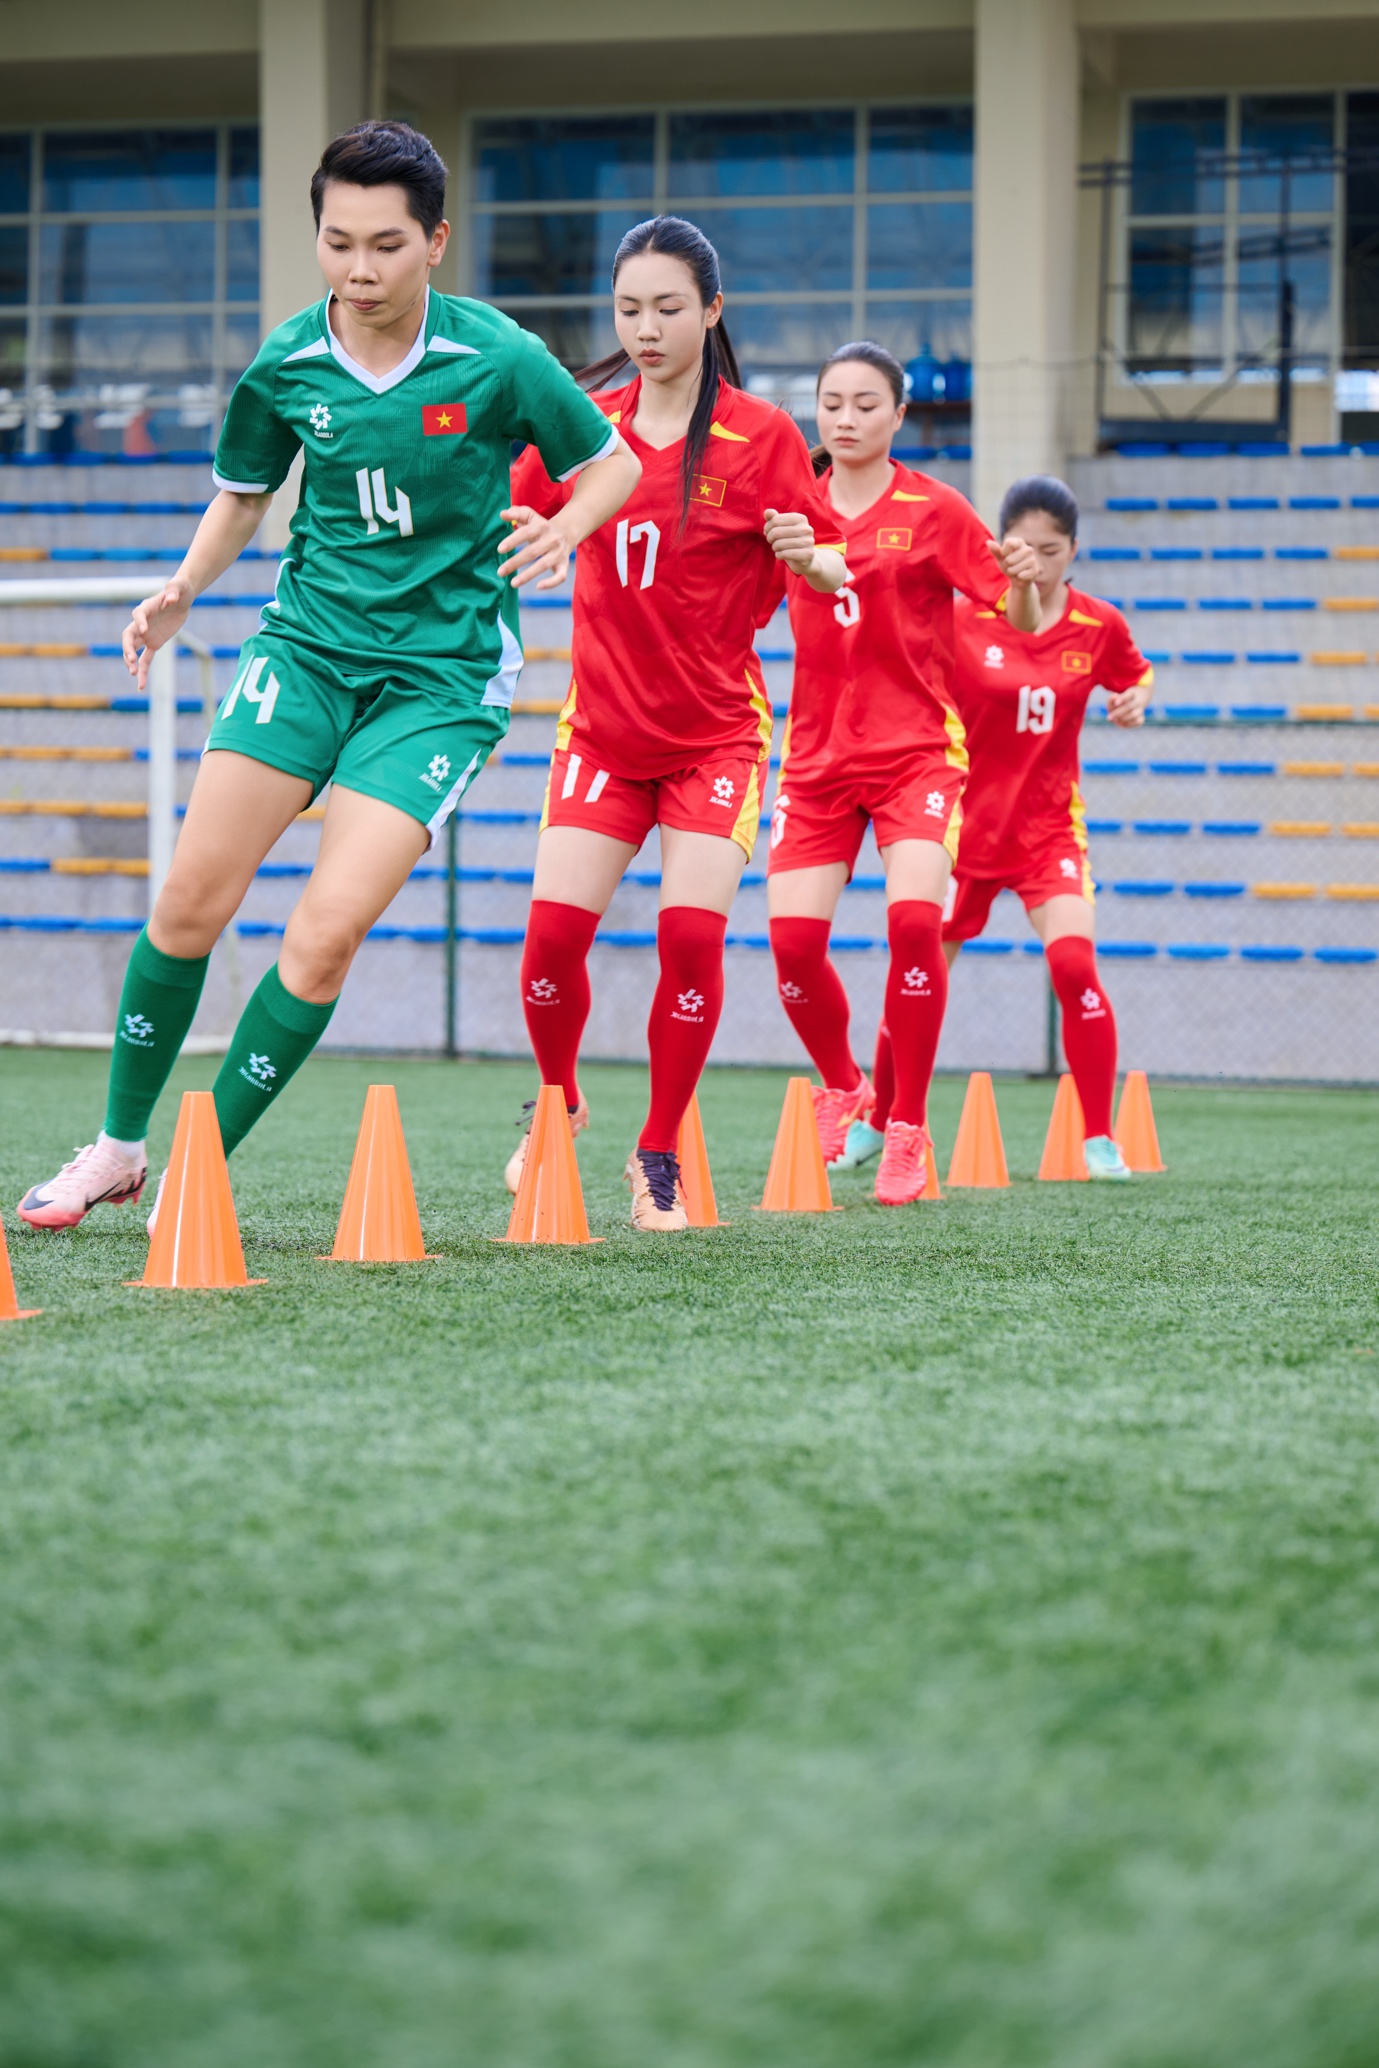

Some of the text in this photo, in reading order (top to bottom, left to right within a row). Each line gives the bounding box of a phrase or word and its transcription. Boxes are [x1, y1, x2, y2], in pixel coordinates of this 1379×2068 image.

[355, 467, 414, 537] 14
[616, 519, 661, 590] 17
[221, 653, 281, 724] 14
[1016, 685, 1056, 735] 19
